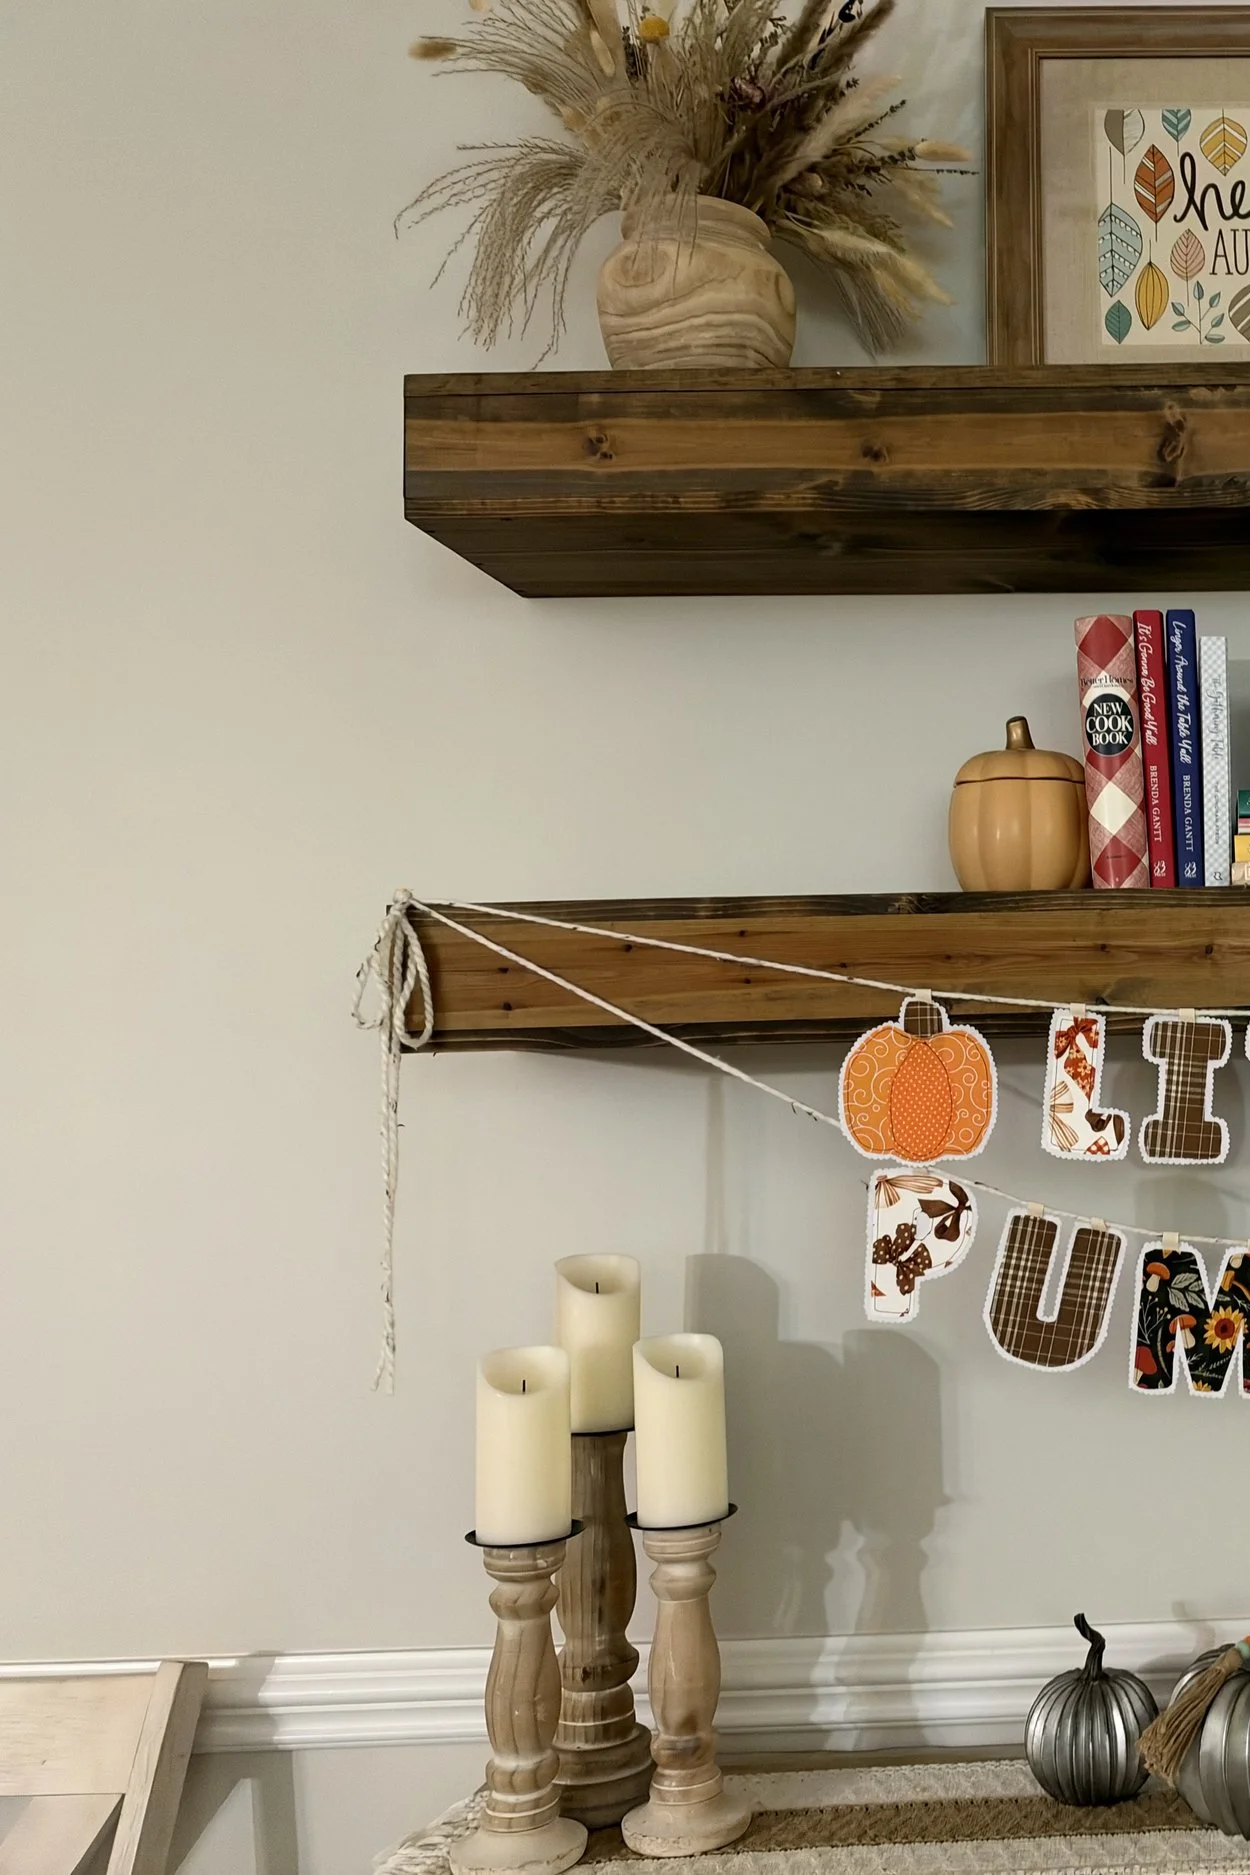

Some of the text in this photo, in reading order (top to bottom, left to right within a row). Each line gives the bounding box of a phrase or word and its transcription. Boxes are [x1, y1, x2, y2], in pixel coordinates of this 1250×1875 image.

[1093, 701, 1123, 716] NEW
[1137, 621, 1158, 746] It's Gonna Be Good Y'all
[1170, 621, 1193, 764] Linger Around the Table Y'all
[1086, 715, 1132, 734] COOK
[1092, 731, 1128, 746] BOOK
[1150, 765, 1162, 842] BRENDA GANTT
[1183, 775, 1194, 852] BRENDA GANTT
